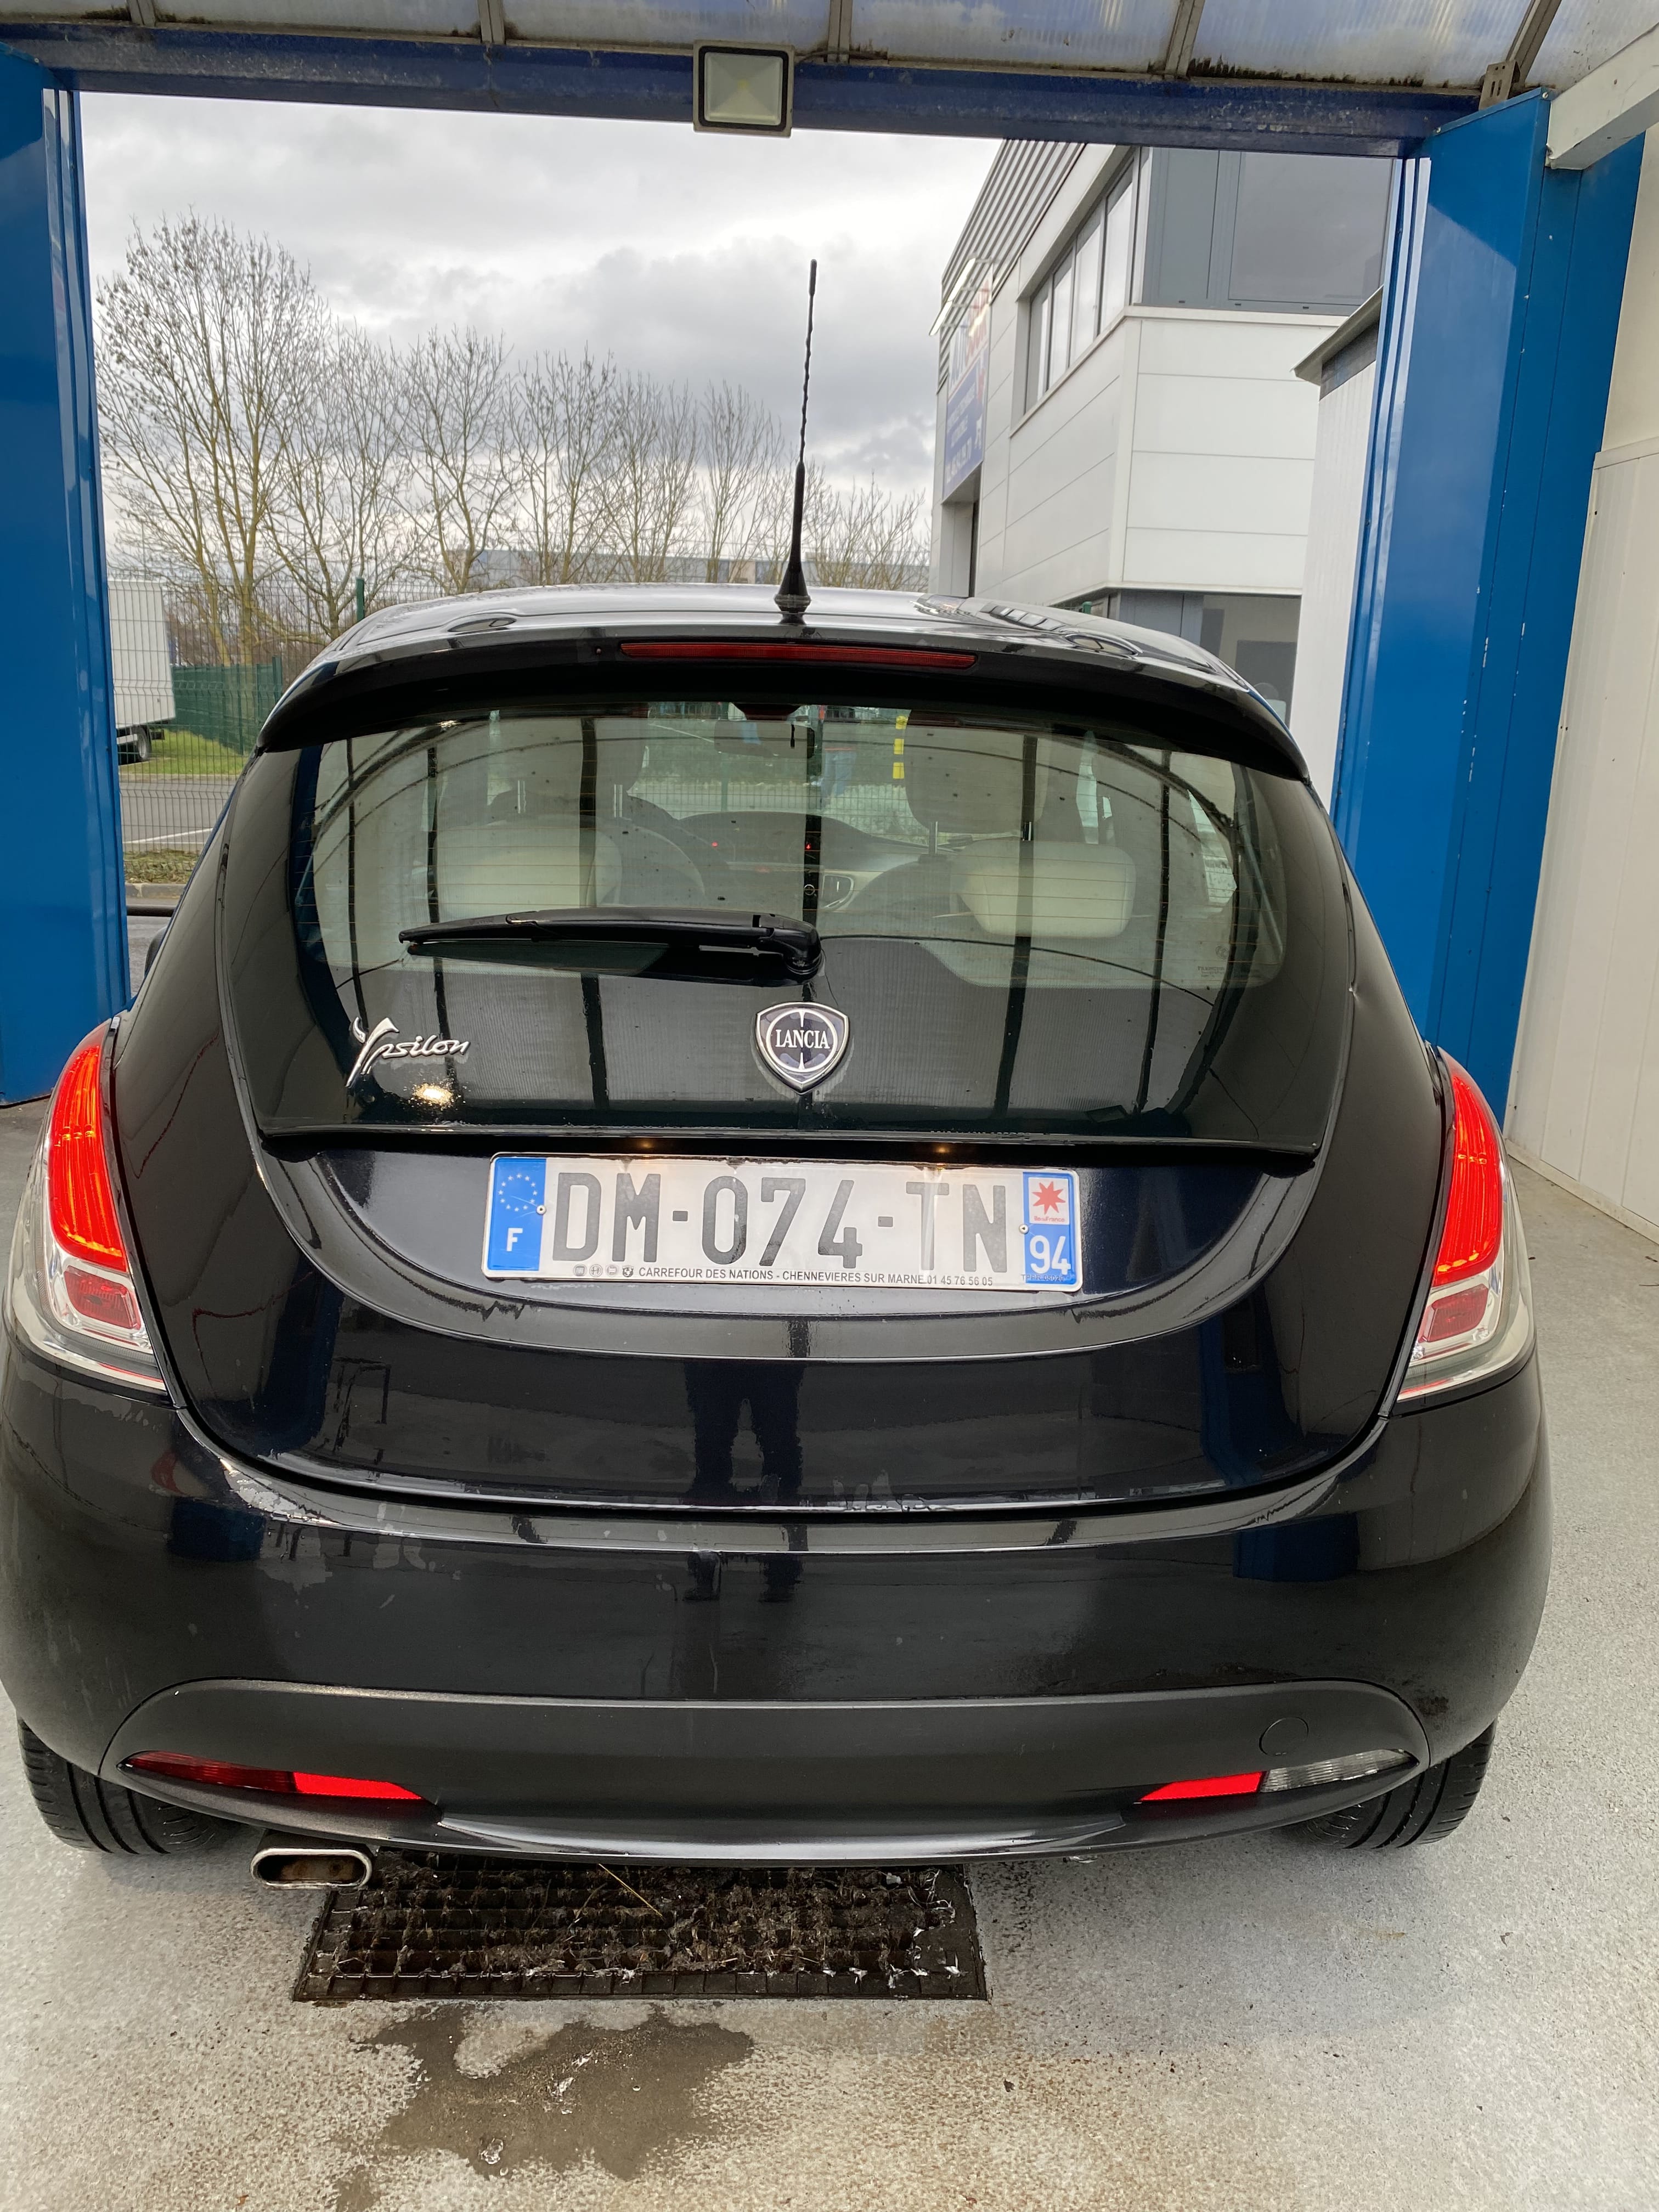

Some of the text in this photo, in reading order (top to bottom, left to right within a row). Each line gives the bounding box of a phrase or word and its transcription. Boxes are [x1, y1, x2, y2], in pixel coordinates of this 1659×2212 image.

[345, 1017, 470, 1087] Ypsilon
[775, 1029, 831, 1048] LANCIA
[552, 1172, 1007, 1273] DM-074-TN
[506, 1228, 523, 1251] F
[1030, 1235, 1071, 1275] 94
[639, 1267, 702, 1278] CARREFOUR
[706, 1269, 726, 1278] DES
[729, 1269, 773, 1279] NATIONS
[782, 1271, 861, 1282] CHENNEVIERES
[864, 1272, 884, 1283] SUR
[888, 1273, 923, 1284] MARNE
[927, 1275, 937, 1284] 01
[940, 1276, 951, 1285] 45
[955, 1276, 965, 1285] 76
[968, 1276, 979, 1285] 56
[982, 1277, 992, 1286] 05
